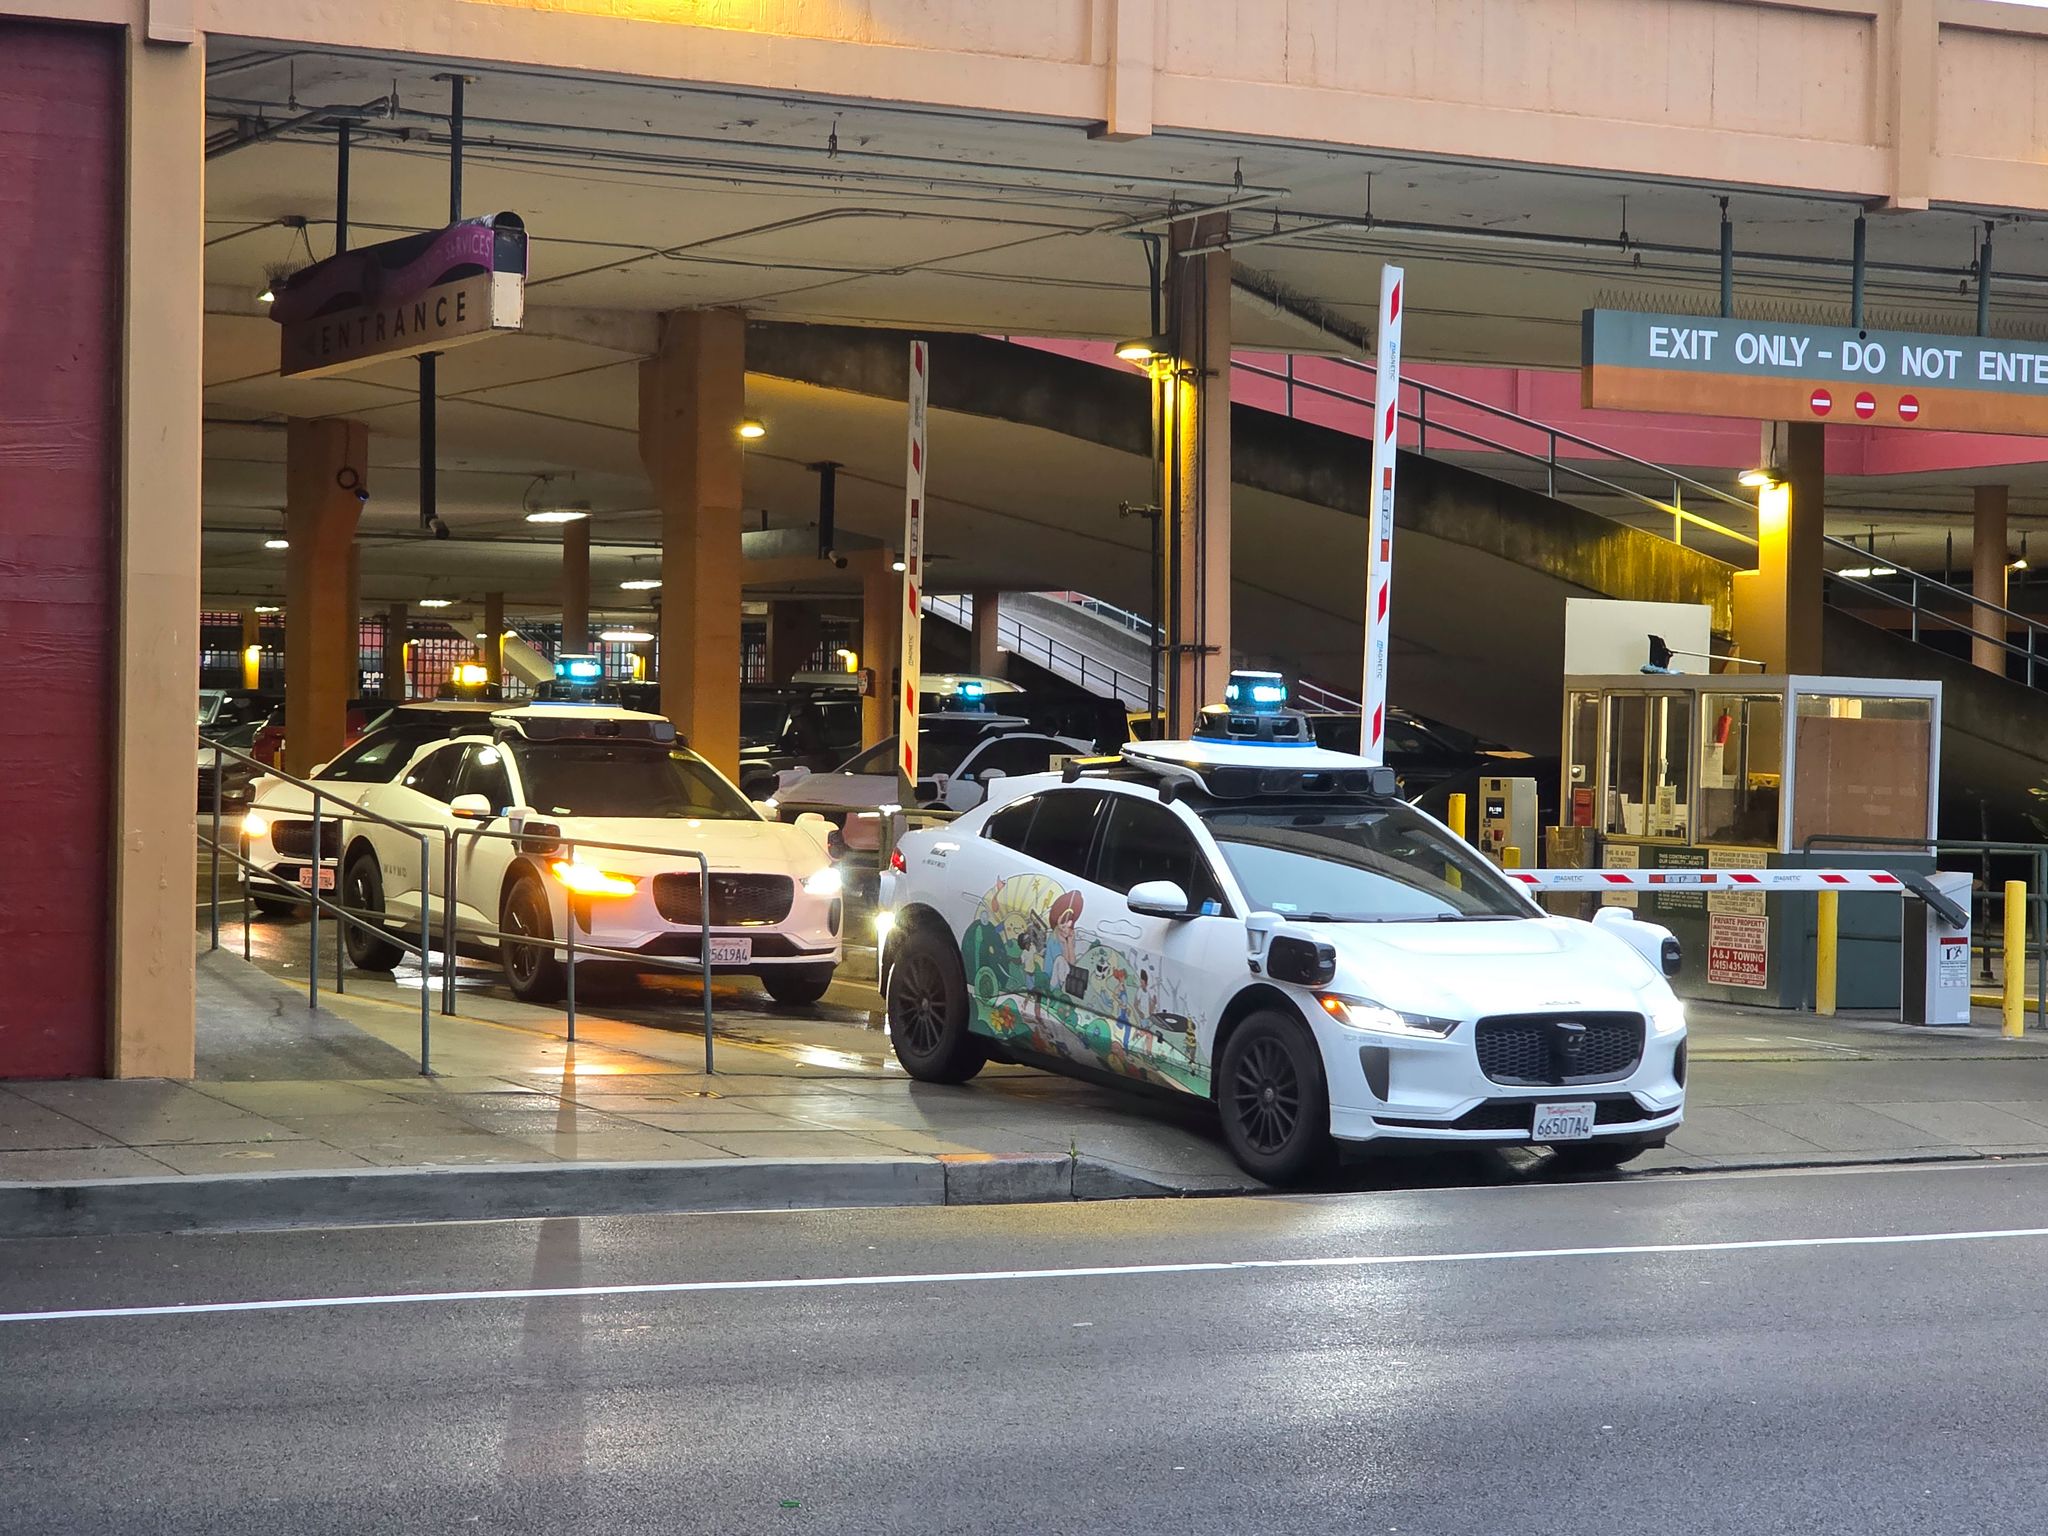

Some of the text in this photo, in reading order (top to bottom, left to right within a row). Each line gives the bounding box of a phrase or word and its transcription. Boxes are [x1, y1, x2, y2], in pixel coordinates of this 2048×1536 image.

[445, 234, 491, 260] SERVICES
[322, 291, 466, 355] ENTRANCE
[1649, 326, 1718, 360] EXIT
[1735, 332, 1810, 368] ONLY
[1842, 341, 1886, 374] DO
[1902, 346, 1963, 380] NOT
[1376, 640, 1384, 679] MAGNETIC
[1553, 874, 1583, 883] MAGNETIC
[1772, 875, 1801, 883] MAGNETIC
[1714, 917, 1765, 928] PRIVATE PROPERTY
[709, 948, 747, 962] 5619A4
[1712, 948, 1764, 963] A&J TOWING
[1537, 1116, 1589, 1136] 66507A4
